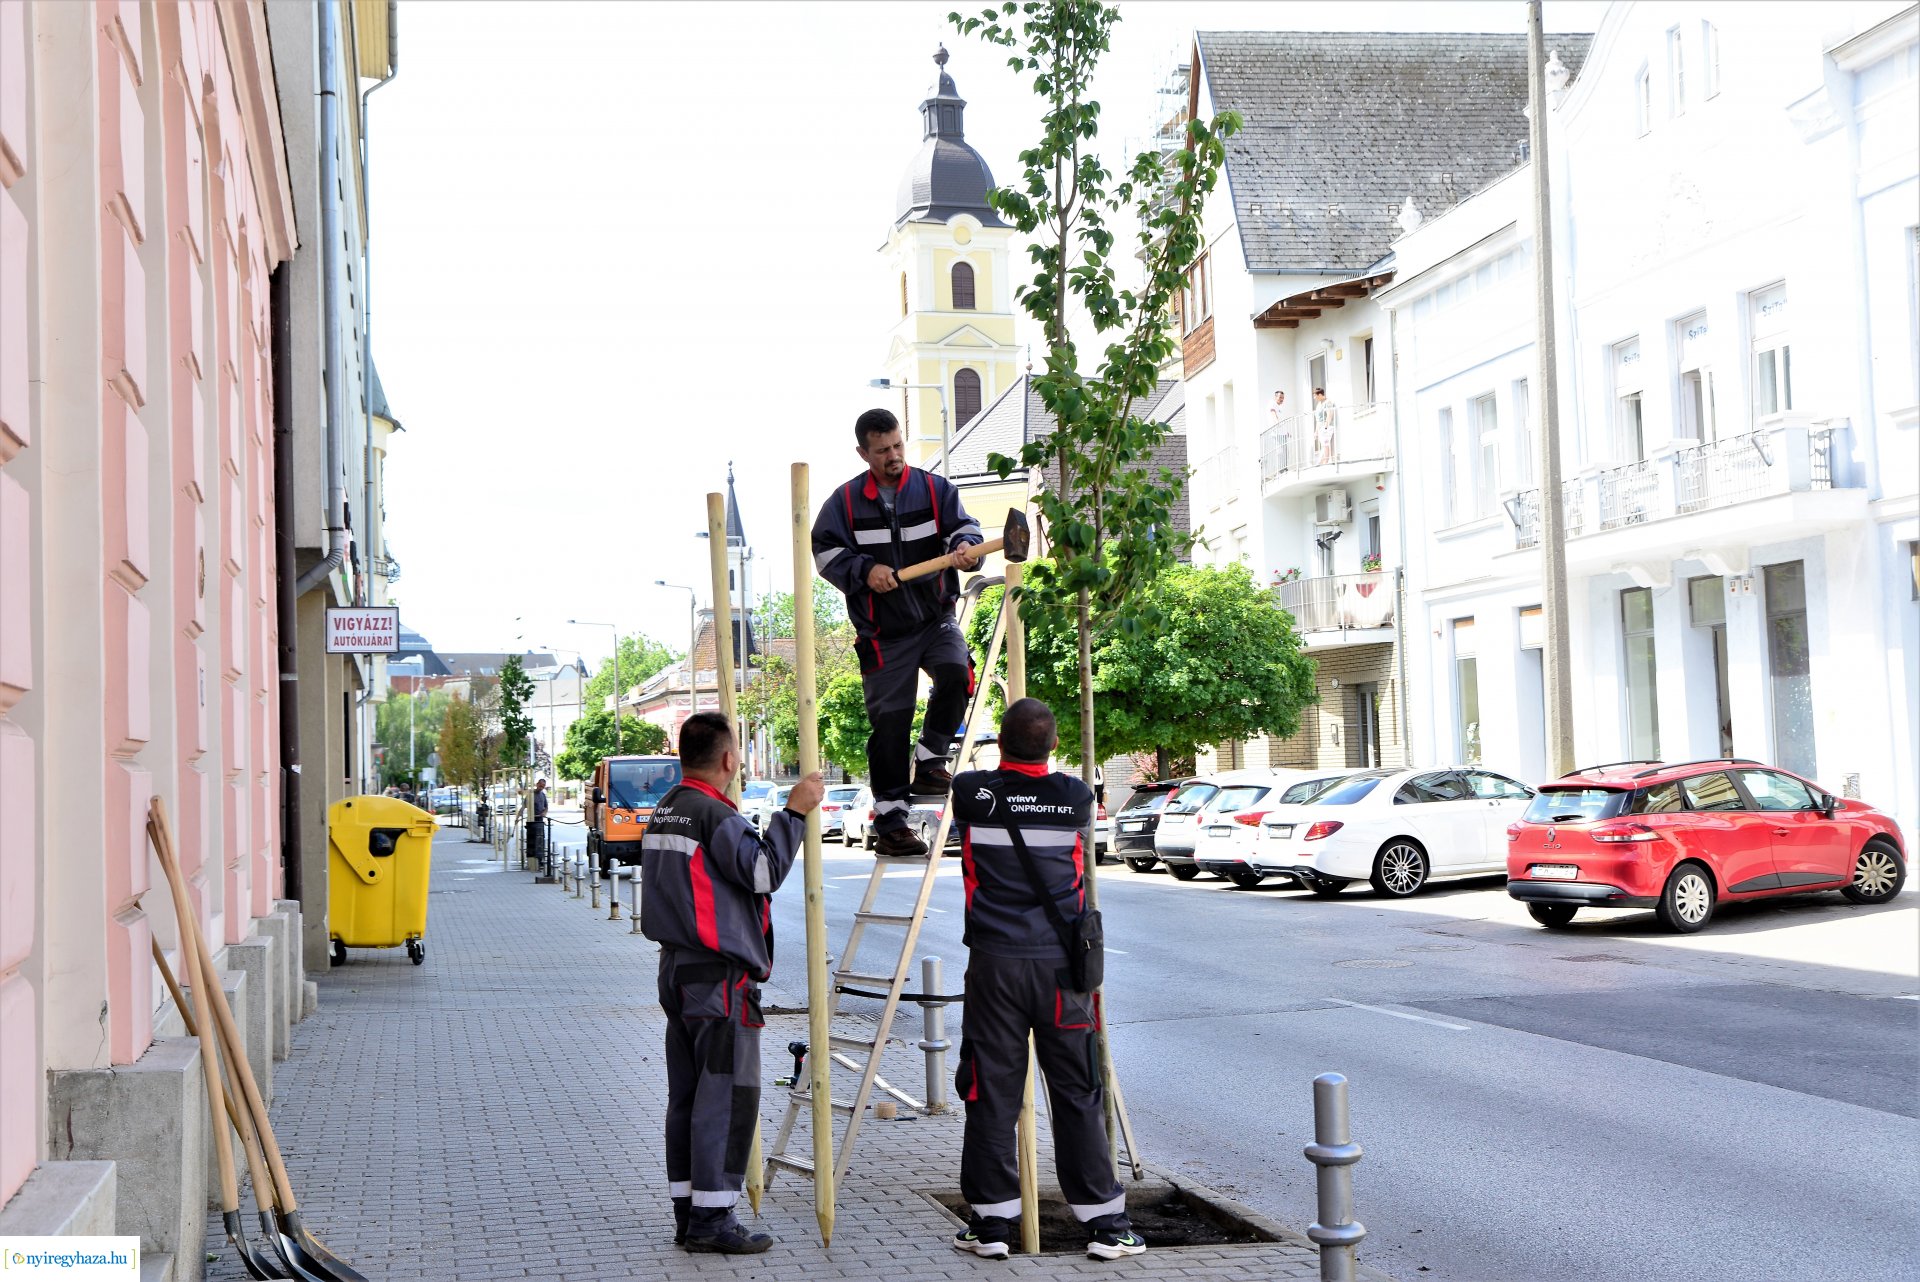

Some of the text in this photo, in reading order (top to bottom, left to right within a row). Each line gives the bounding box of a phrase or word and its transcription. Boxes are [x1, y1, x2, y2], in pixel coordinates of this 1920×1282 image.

[333, 613, 393, 631] VIGYÁZZ!
[333, 633, 393, 647] AUTÓKIJÁRAT
[1009, 804, 1075, 815] ONPROFIT KFT.
